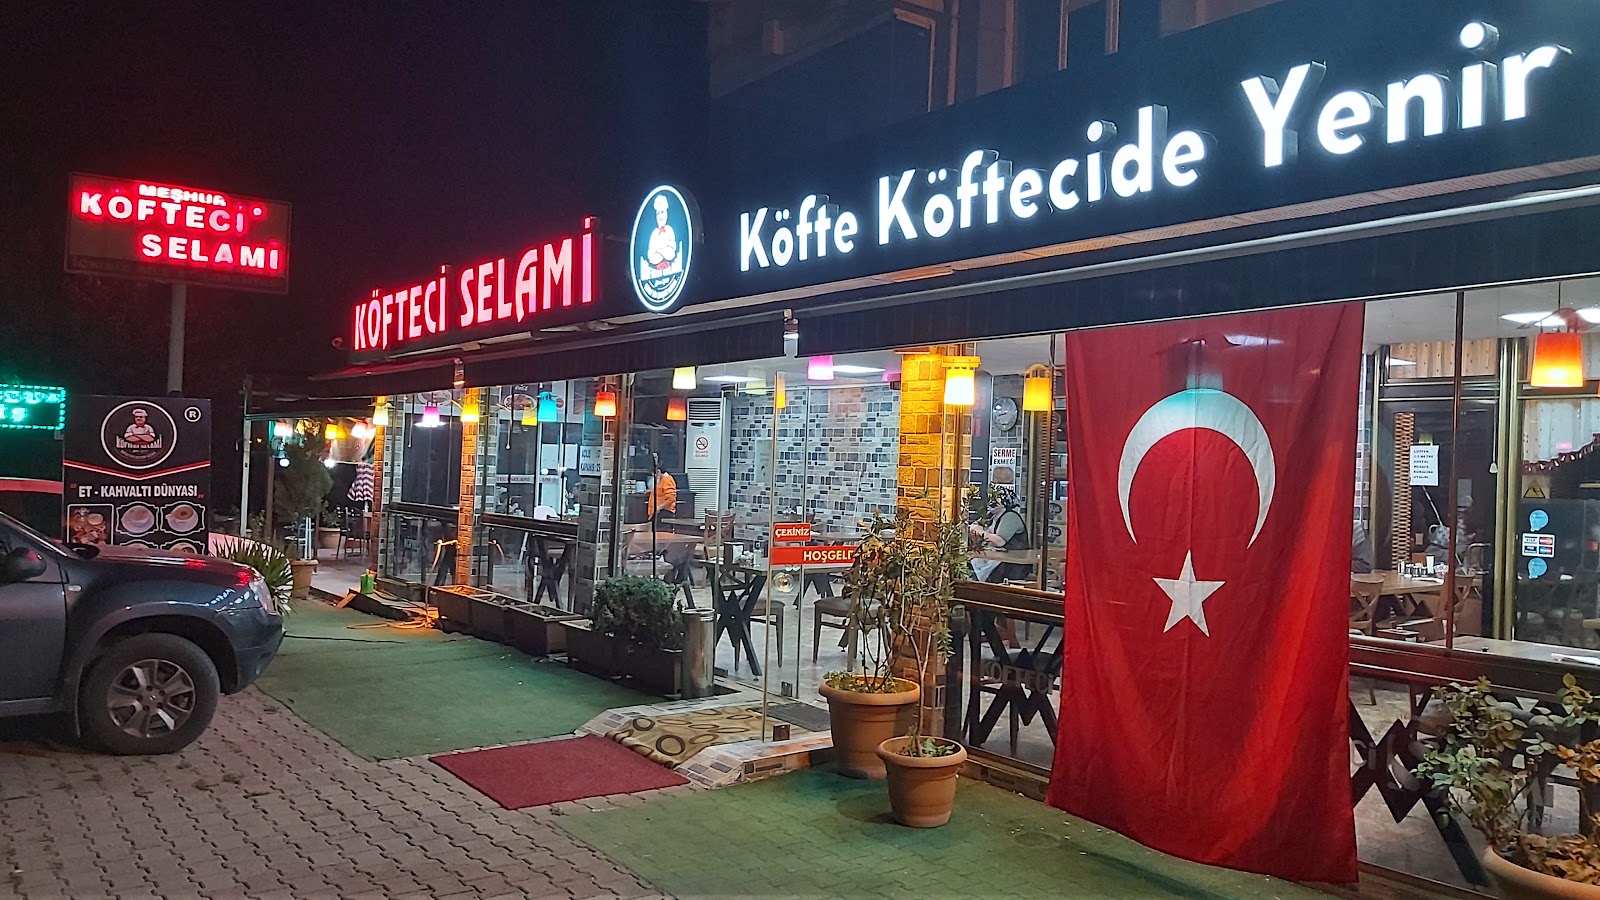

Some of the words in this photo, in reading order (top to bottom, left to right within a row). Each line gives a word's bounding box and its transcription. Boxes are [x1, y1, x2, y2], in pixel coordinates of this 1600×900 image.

[740, 194, 858, 272] Köfte
[878, 105, 1206, 245] Köftecide
[1240, 21, 1559, 168] Yenir
[354, 265, 447, 351] KÖFTECİ
[460, 217, 593, 328] SELAMİ
[993, 449, 1015, 458] SERME
[78, 485, 93, 498] ET
[100, 485, 151, 498] KAHVALTI
[153, 483, 198, 497] DÜNYASI
[775, 526, 810, 539] ÇEKİNİZ
